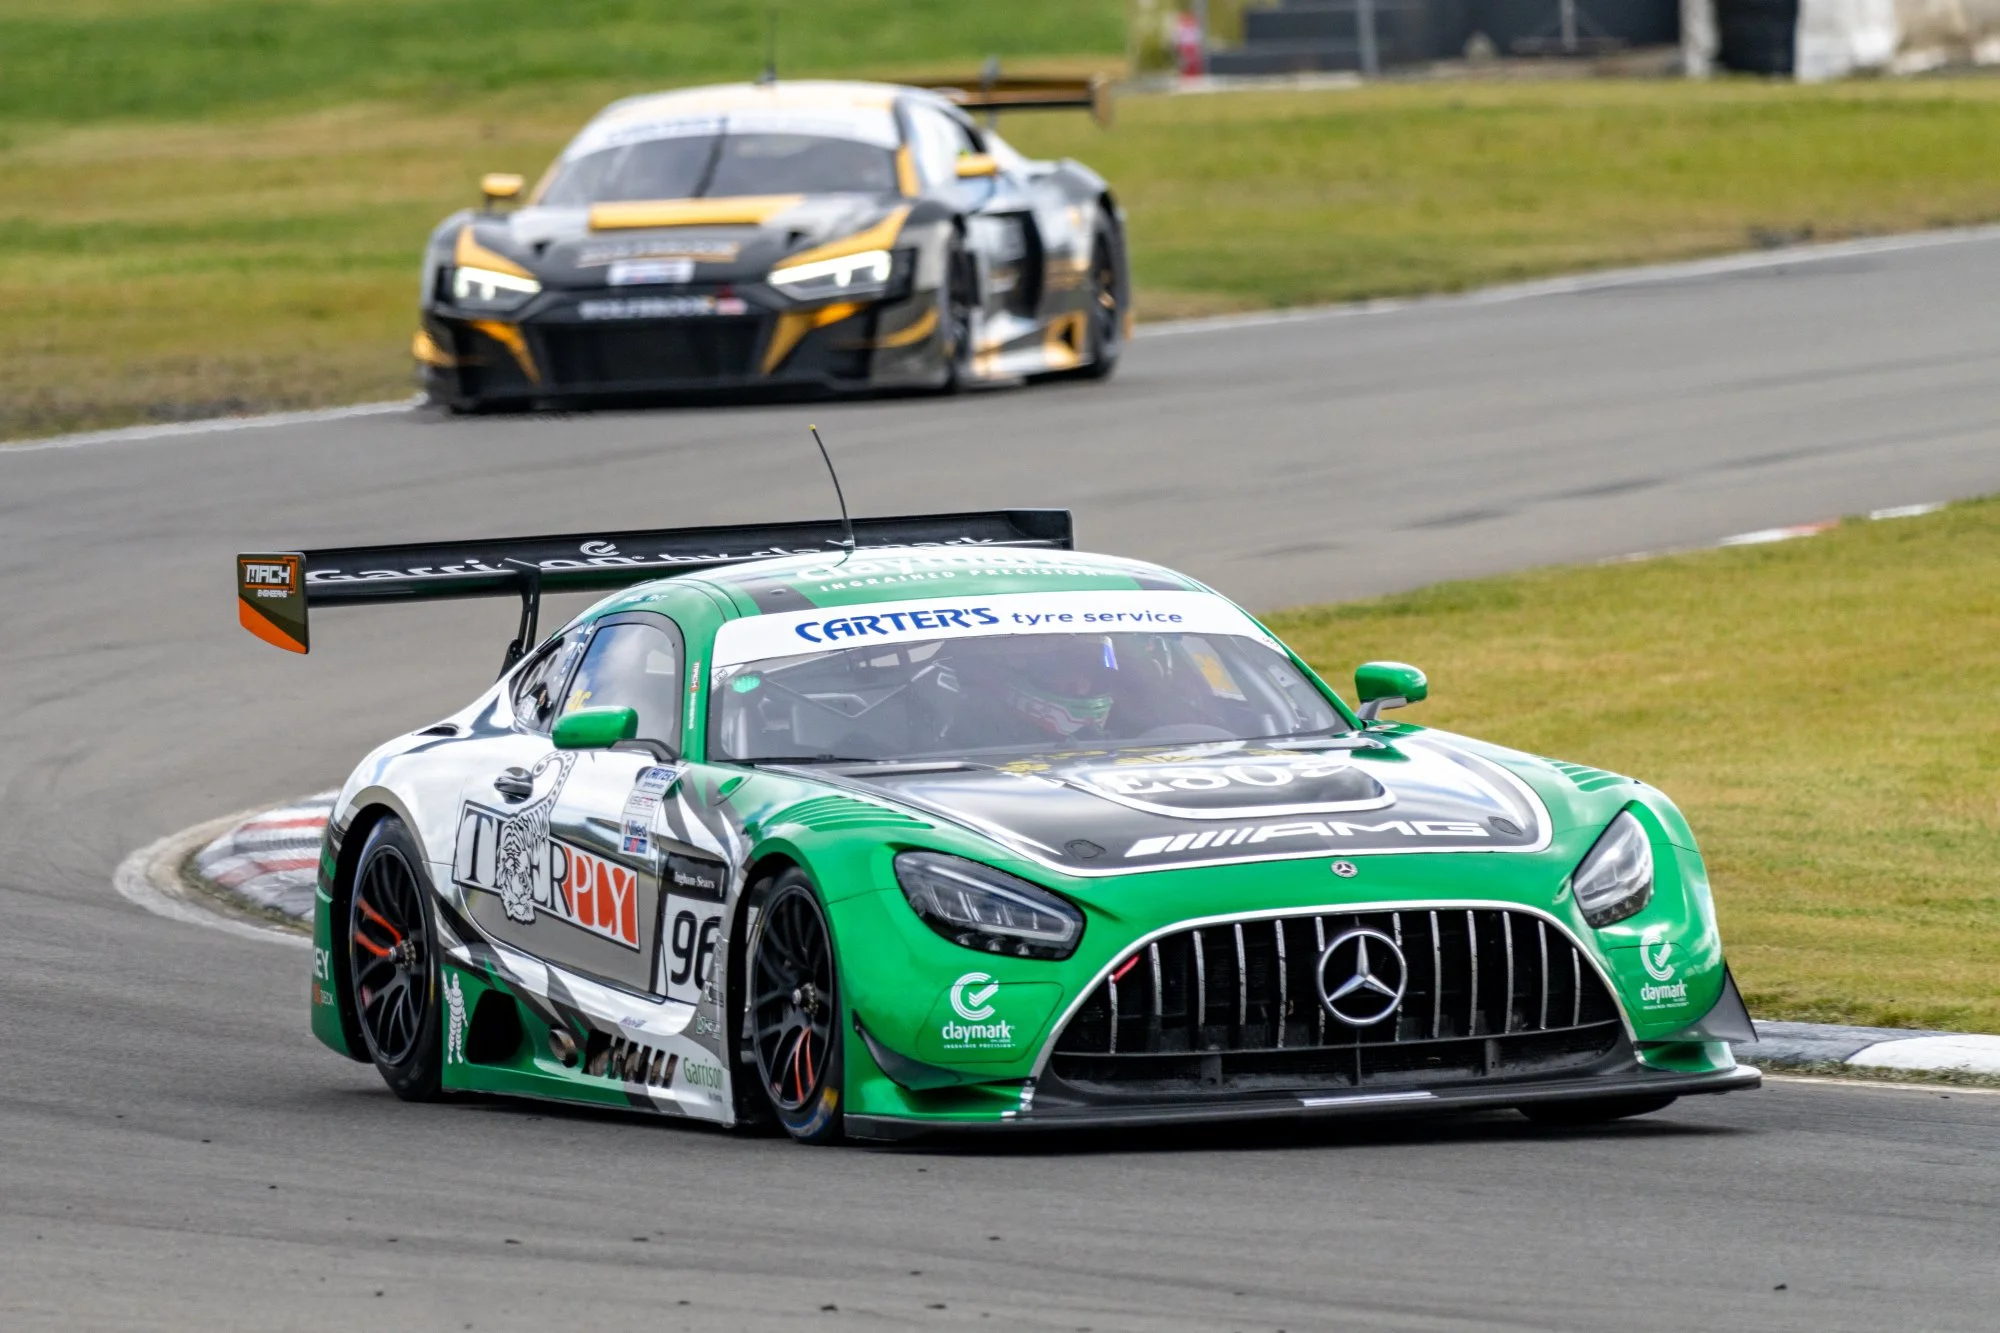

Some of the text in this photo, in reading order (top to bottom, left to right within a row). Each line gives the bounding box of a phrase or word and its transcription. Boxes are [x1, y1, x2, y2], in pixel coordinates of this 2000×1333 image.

[246, 564, 291, 584] MACH
[304, 557, 637, 583] Garrion
[819, 571, 955, 592] INGRAINED
[795, 607, 1183, 643] CARTER'S tyre service
[1247, 821, 1490, 843] AMG
[463, 807, 638, 948] TIERPLY
[1640, 979, 1687, 1004] claymark
[942, 1019, 1012, 1044] claymark
